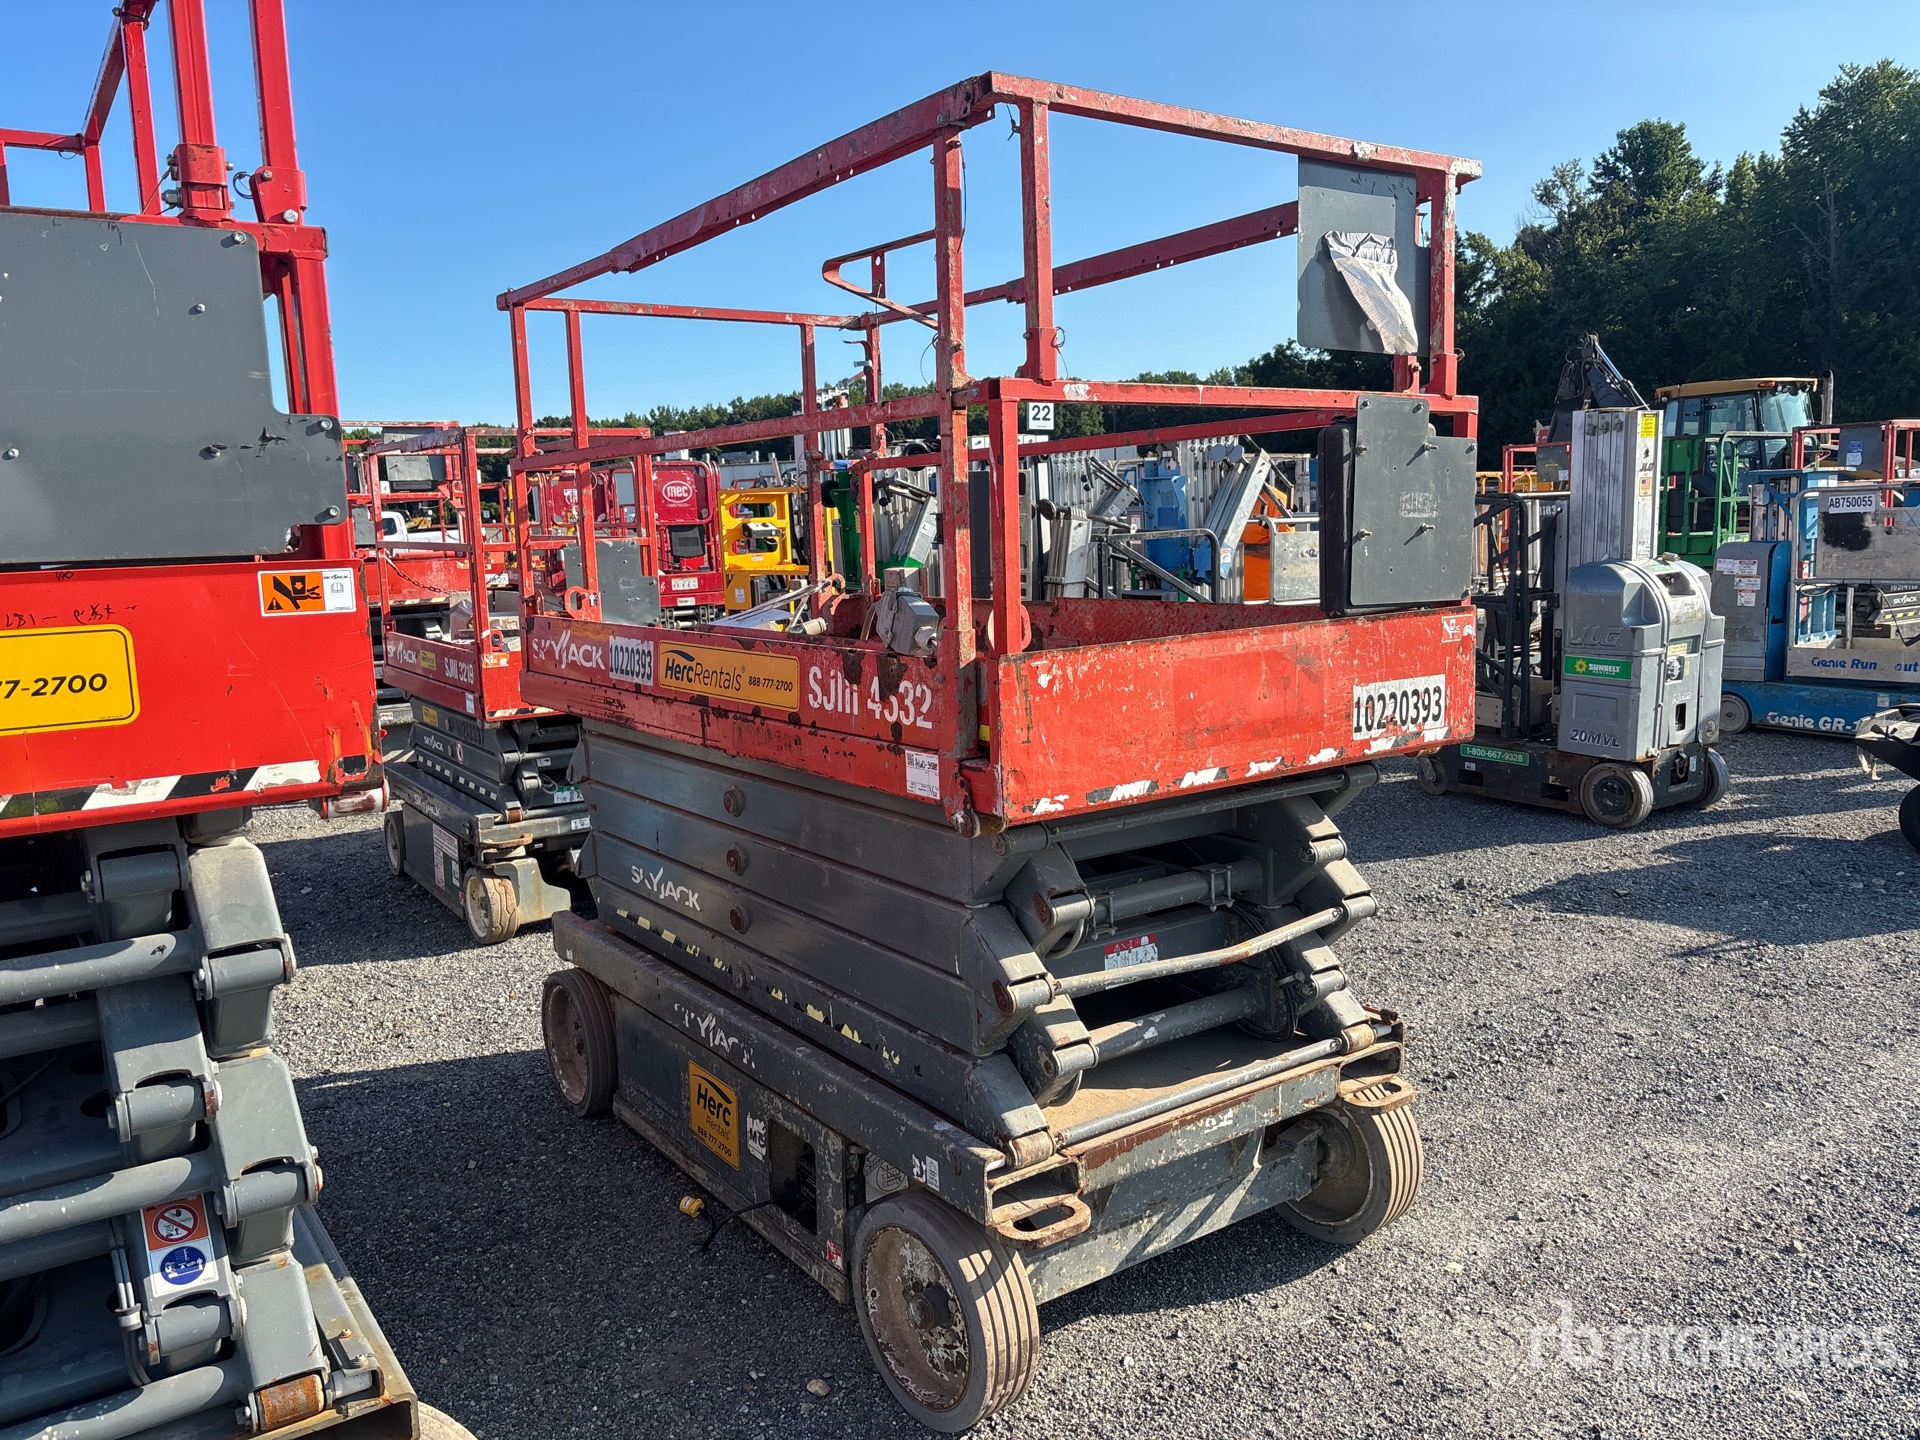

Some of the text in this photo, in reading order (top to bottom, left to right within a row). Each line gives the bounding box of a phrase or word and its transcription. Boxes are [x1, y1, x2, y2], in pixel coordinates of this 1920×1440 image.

[1031, 404, 1051, 421] 22
[1829, 495, 1873, 509] AB750055
[1569, 624, 1622, 648] JLG
[532, 628, 606, 670] SKYJACK
[609, 644, 652, 681] 10220393
[1588, 663, 1621, 673] SUNBELT
[1811, 656, 1847, 669] Genie
[0, 672, 108, 700] 7-2700
[748, 675, 793, 692] 888-777-2700
[1353, 685, 1442, 734] 10220393
[1766, 711, 1814, 729] Genie
[1466, 746, 1523, 762] 1-800-667-9328
[696, 1082, 732, 1127] Herc
[706, 1115, 731, 1141] Rentals
[697, 1125, 732, 1157] 888-777-2700
